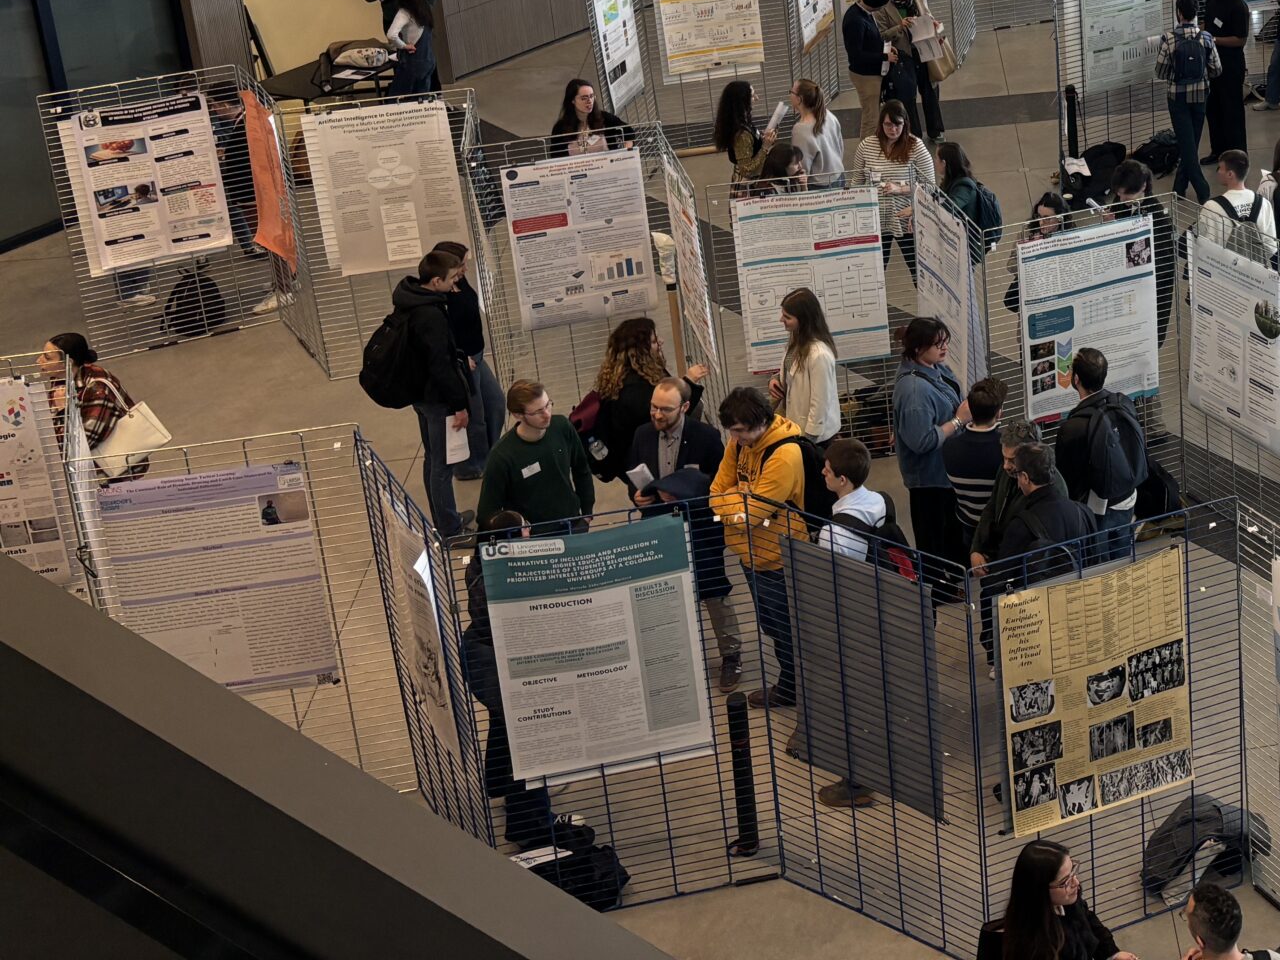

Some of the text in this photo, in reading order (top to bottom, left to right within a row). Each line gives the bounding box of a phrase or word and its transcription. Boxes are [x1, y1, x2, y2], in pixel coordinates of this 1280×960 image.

[318, 117, 343, 125] Artificial
[344, 114, 377, 123] Intelligence
[386, 108, 423, 117] Conservation
[485, 544, 509, 557] UC
[517, 541, 556, 550] Universidad
[528, 546, 561, 554] Cantabria
[508, 559, 548, 567] NARRATIVES
[560, 553, 596, 562] INCLUSION
[613, 542, 650, 554] EXCLUSION
[578, 554, 615, 565] EDUCATION
[506, 574, 547, 583] PRIORITIZED
[548, 572, 578, 580] INTEREST
[580, 566, 606, 576] GROUPS
[625, 554, 663, 566] COLOMBIAN
[515, 568, 560, 577] TRAJECTORIES
[573, 561, 605, 572] STUDENTS
[606, 553, 644, 565] BELONGING
[567, 572, 605, 583] UNIVERSITY
[634, 581, 661, 592] RESULTS
[635, 585, 676, 599] DISCUSSION
[529, 597, 593, 611] INTRODUCTION
[1003, 595, 1040, 609] Infanticide
[1001, 619, 1044, 634] fragmentary
[1007, 627, 1040, 641] plays and
[1008, 644, 1041, 654] influence
[1020, 649, 1041, 660] Visual
[577, 664, 628, 678] METHODOLOGY
[522, 676, 558, 687] OBJECTIVE
[517, 709, 572, 722] CONTRIBUTIONS
[533, 706, 554, 715] STUDY
